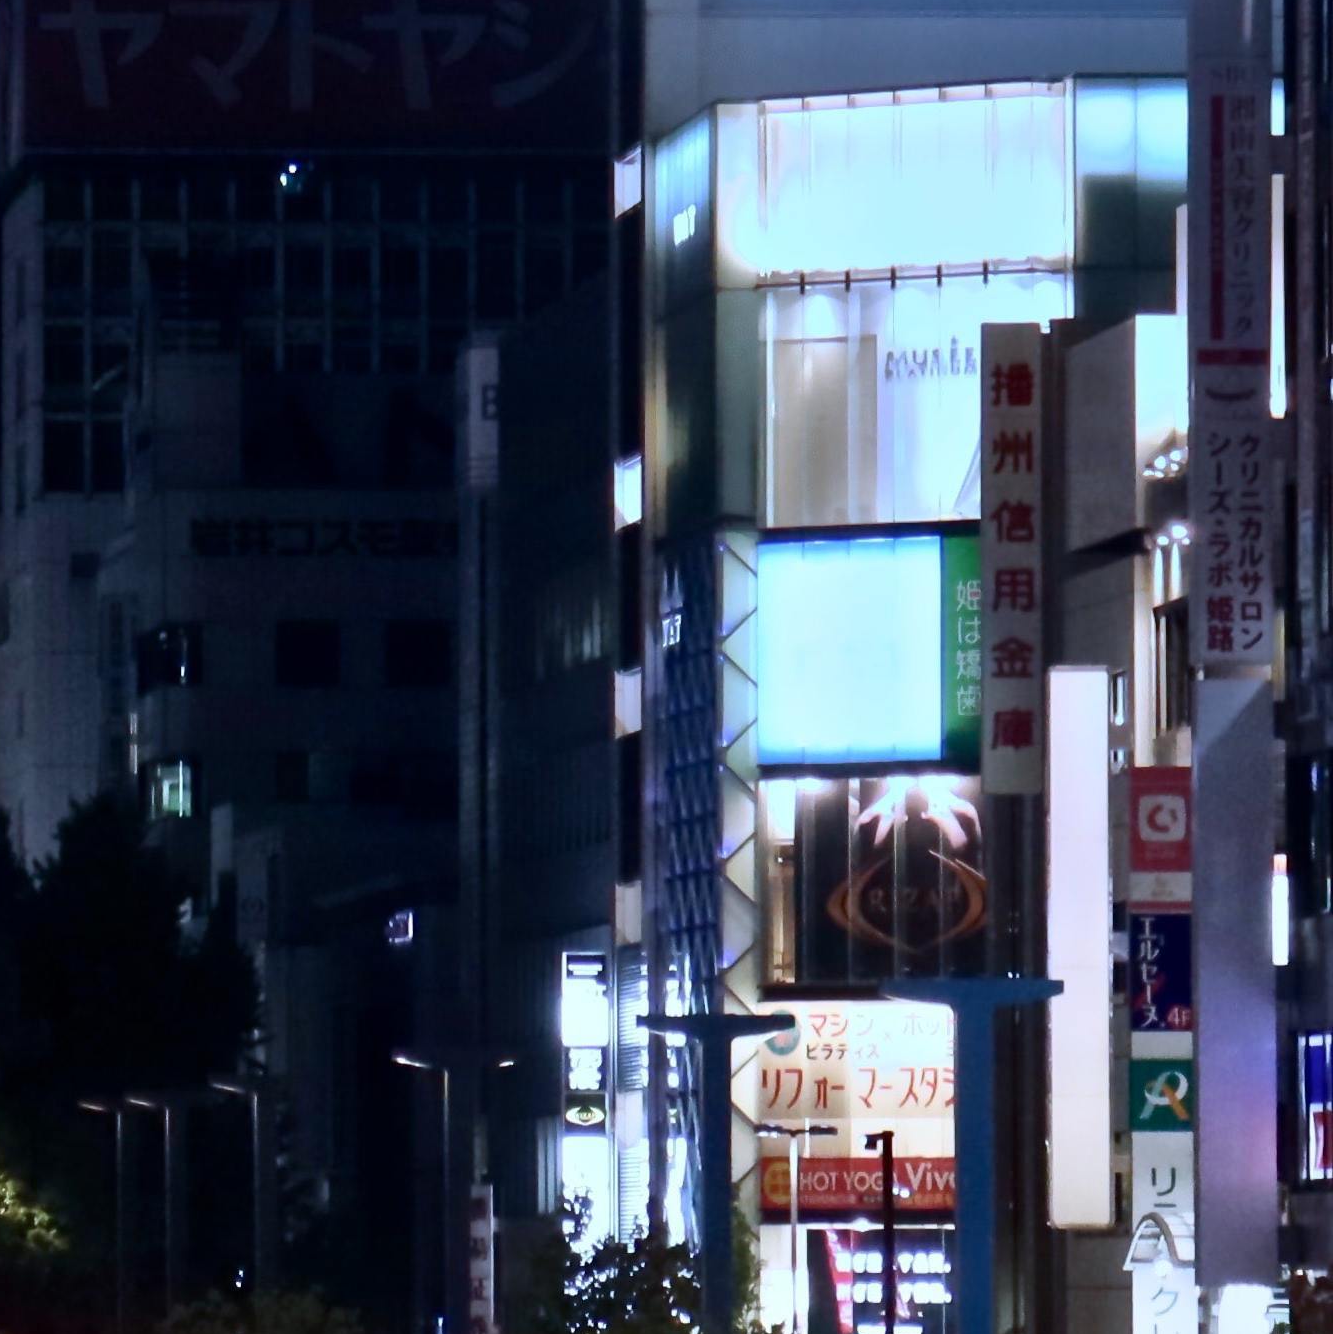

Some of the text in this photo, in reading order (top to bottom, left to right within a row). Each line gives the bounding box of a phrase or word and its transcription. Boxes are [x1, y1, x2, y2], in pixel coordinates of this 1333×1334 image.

[989, 362, 1035, 751] 播州信用金庫
[1238, 433, 1264, 651] クリニカルサロン
[800, 1170, 837, 1191] HOT
